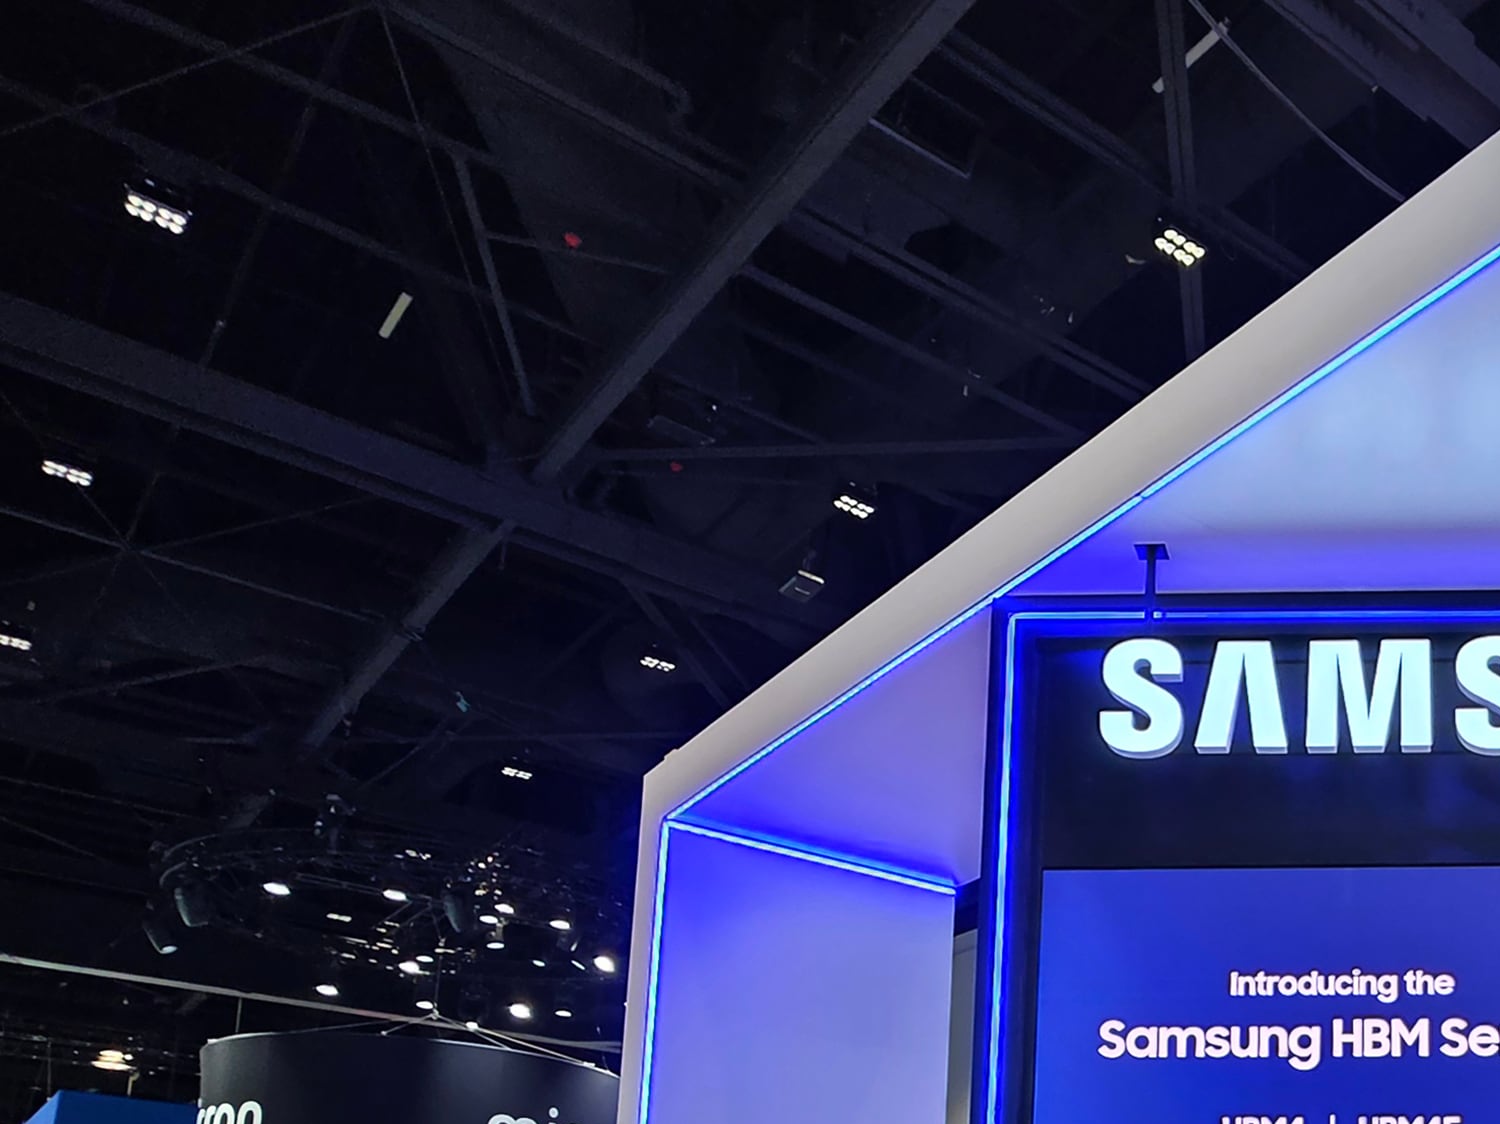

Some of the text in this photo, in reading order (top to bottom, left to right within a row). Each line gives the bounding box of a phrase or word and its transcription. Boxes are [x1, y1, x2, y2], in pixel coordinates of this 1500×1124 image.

[1230, 968, 1455, 1003] Introducing the
[1098, 1019, 1321, 1070] Samsung
[1332, 1018, 1430, 1058] HBM
